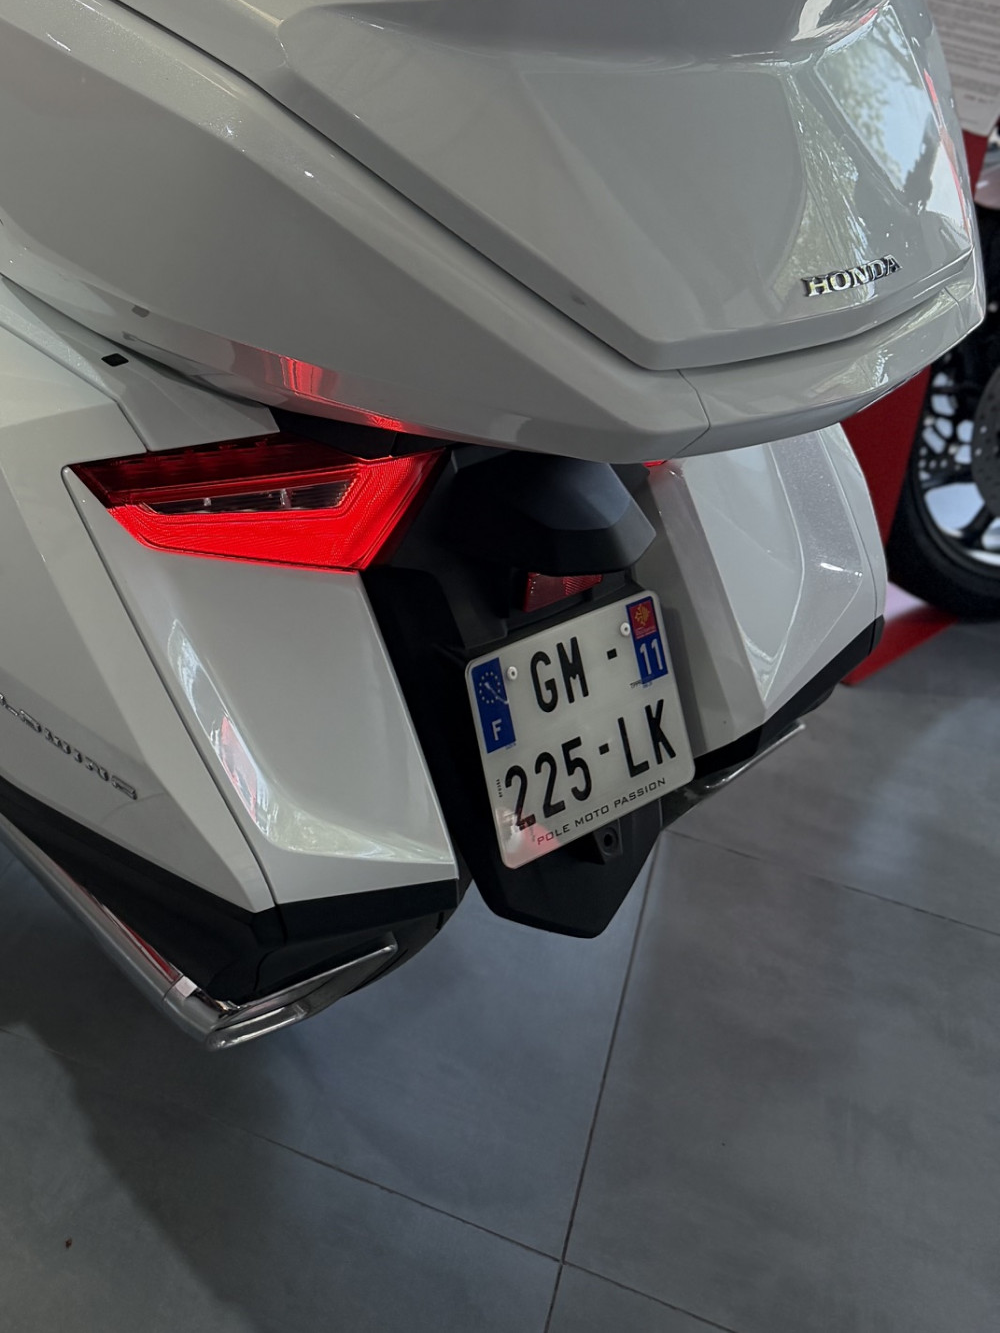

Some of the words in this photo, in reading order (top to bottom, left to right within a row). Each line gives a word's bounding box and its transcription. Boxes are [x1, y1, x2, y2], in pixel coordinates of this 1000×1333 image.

[801, 254, 902, 297] HONDA
[640, 638, 663, 675] 11
[492, 719, 503, 741] F
[505, 699, 676, 831] 225-LK
[537, 824, 570, 845] POLE
[575, 805, 609, 827] MOTO
[613, 777, 666, 808] PASSION
